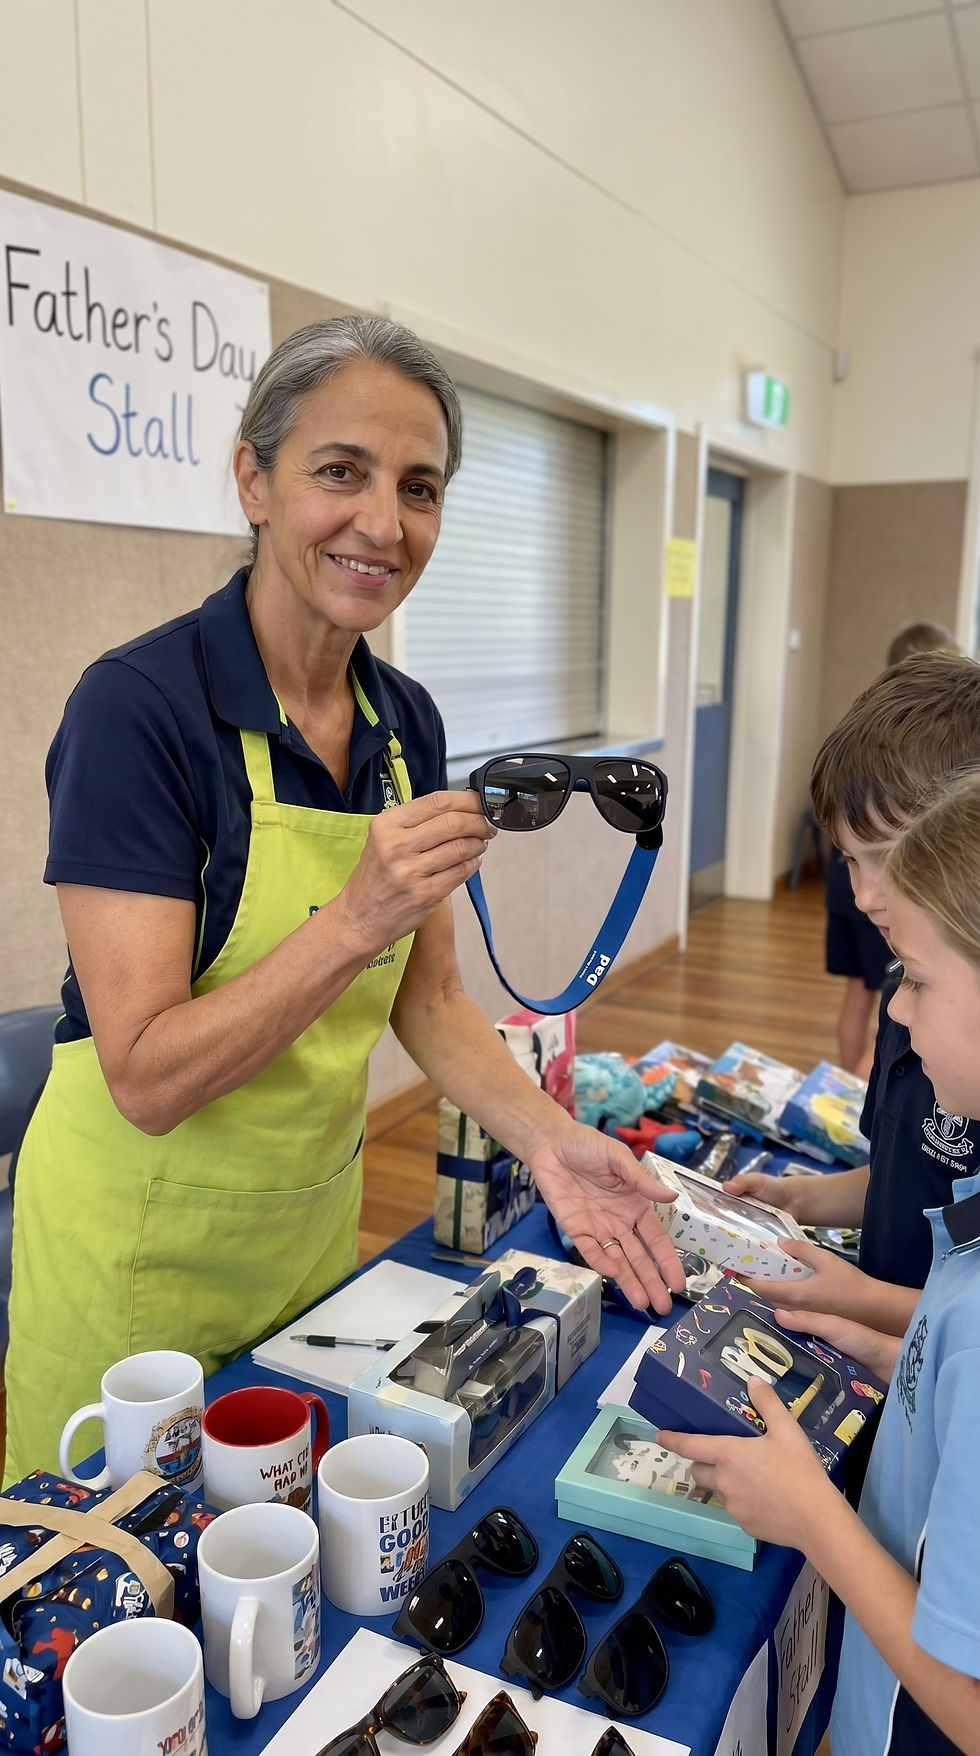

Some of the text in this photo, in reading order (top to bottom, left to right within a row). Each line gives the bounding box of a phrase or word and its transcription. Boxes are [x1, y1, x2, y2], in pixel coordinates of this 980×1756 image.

[5, 244, 173, 362] Father's
[87, 373, 200, 466] Stall
[585, 953, 611, 987] Dad
[260, 1459, 294, 1480] WHAT
[786, 1621, 819, 1733] Stall
